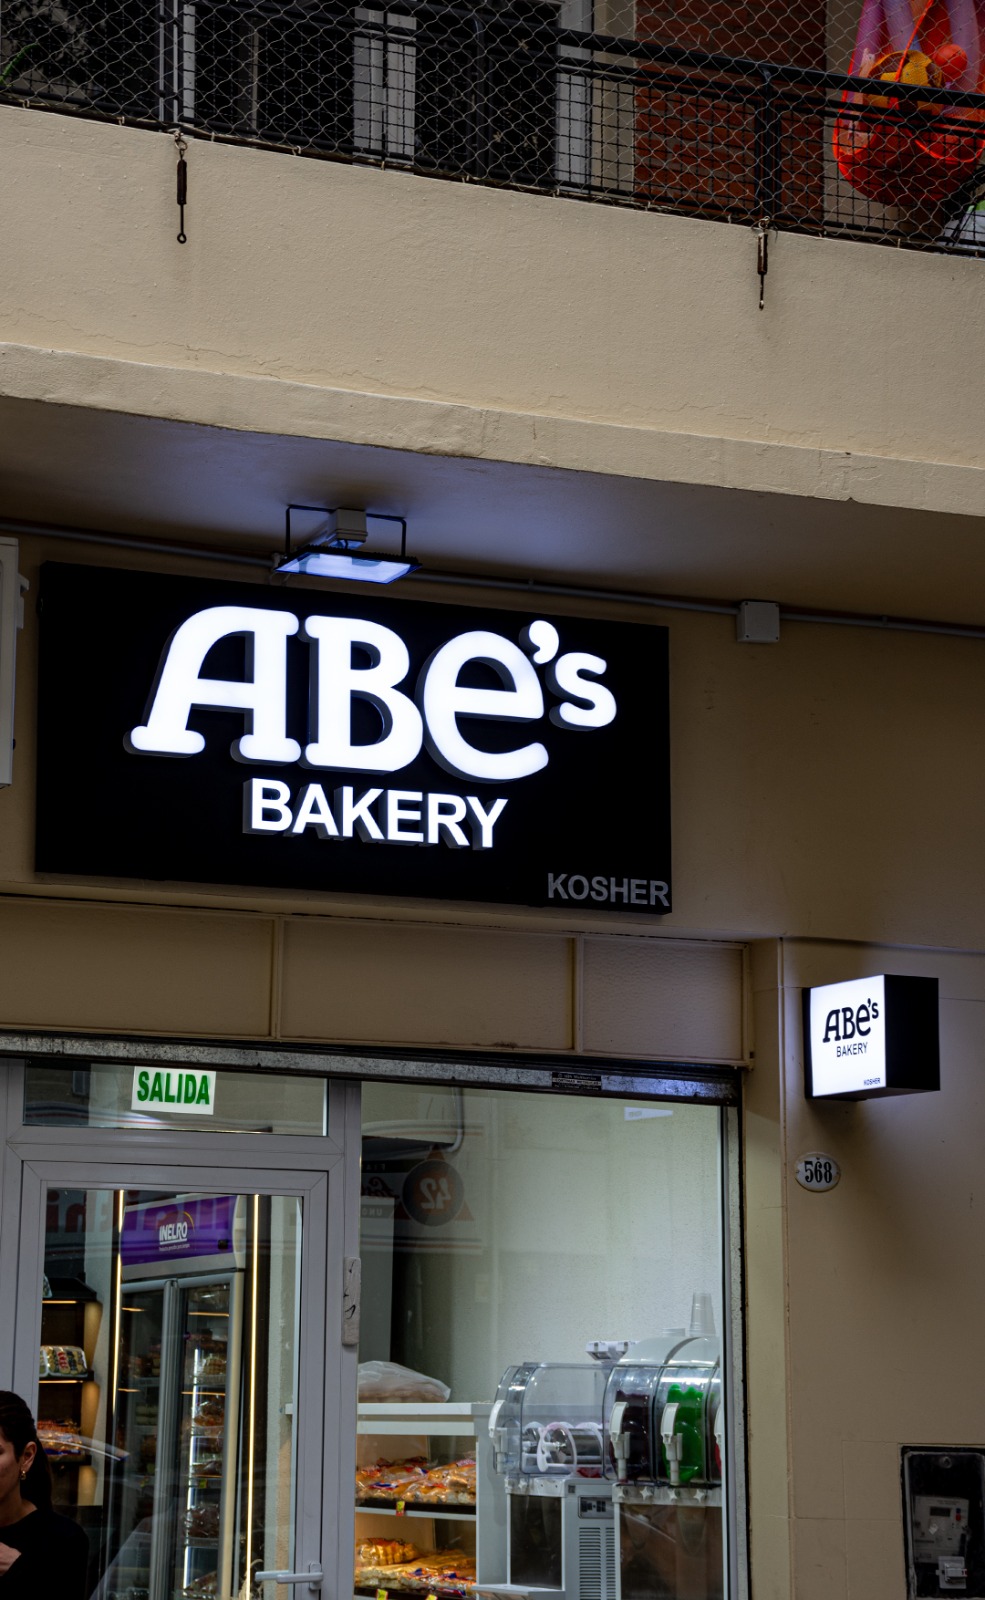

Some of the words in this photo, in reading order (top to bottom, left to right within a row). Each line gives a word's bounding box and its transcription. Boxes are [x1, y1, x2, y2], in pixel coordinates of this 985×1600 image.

[130, 605, 617, 780] ABe's
[251, 777, 509, 848] BAKERY
[547, 872, 670, 907] KOSHER
[822, 997, 880, 1043] ABe's
[836, 1041, 869, 1058] BAKERY
[136, 1070, 210, 1105] SALIDA
[863, 1077, 881, 1087] KOSHER
[804, 1160, 833, 1184] 568
[158, 1221, 188, 1242] INELRO
